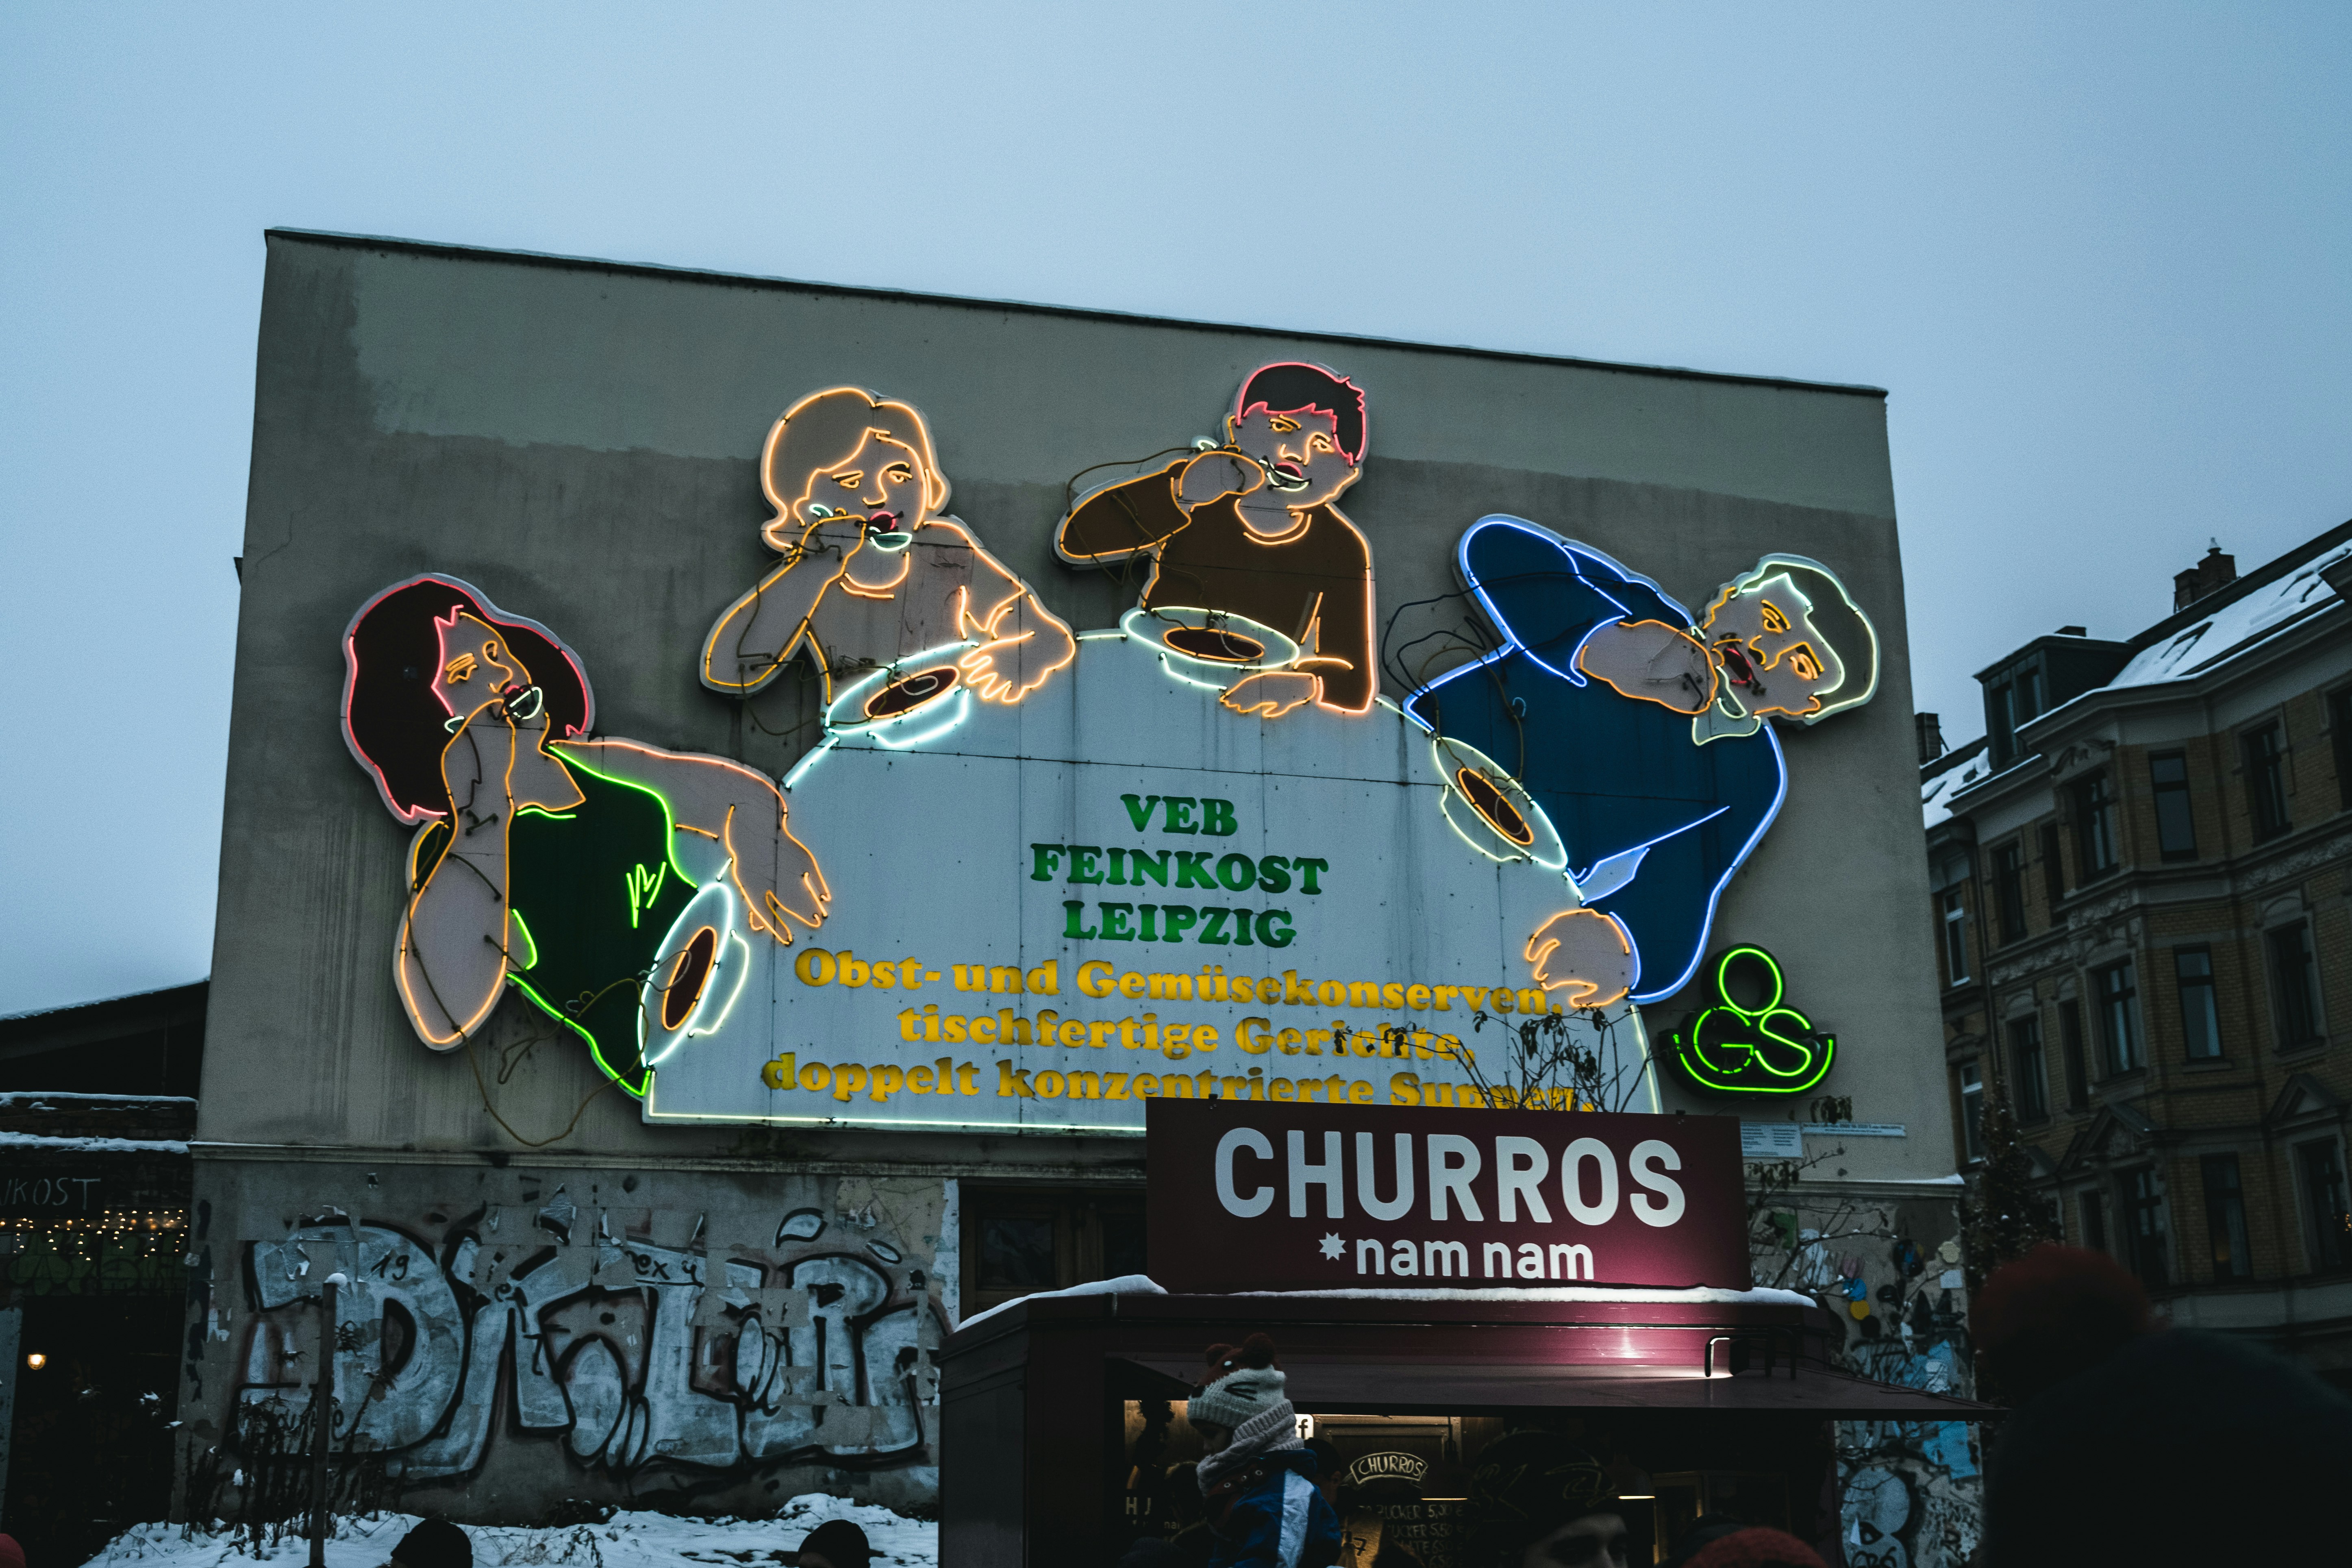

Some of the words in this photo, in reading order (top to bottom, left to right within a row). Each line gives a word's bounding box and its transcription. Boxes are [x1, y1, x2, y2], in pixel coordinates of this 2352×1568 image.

[1120, 794, 1238, 836] VEB
[1030, 843, 1329, 895] FEINKOST
[1062, 900, 1297, 948] LEIPZIG
[794, 948, 941, 990] Obst-
[952, 959, 1060, 996] und
[896, 1003, 1219, 1060] tischfertige
[762, 1052, 980, 1103] doppelt
[996, 1059, 1374, 1105] konzentrierte
[1214, 1127, 1686, 1227] CHURROS
[1356, 1238, 1469, 1275] nam
[1483, 1241, 1594, 1280] nam
[1358, 1455, 1423, 1477] CHURROS
[1389, 1523, 1428, 1538] UCKER
